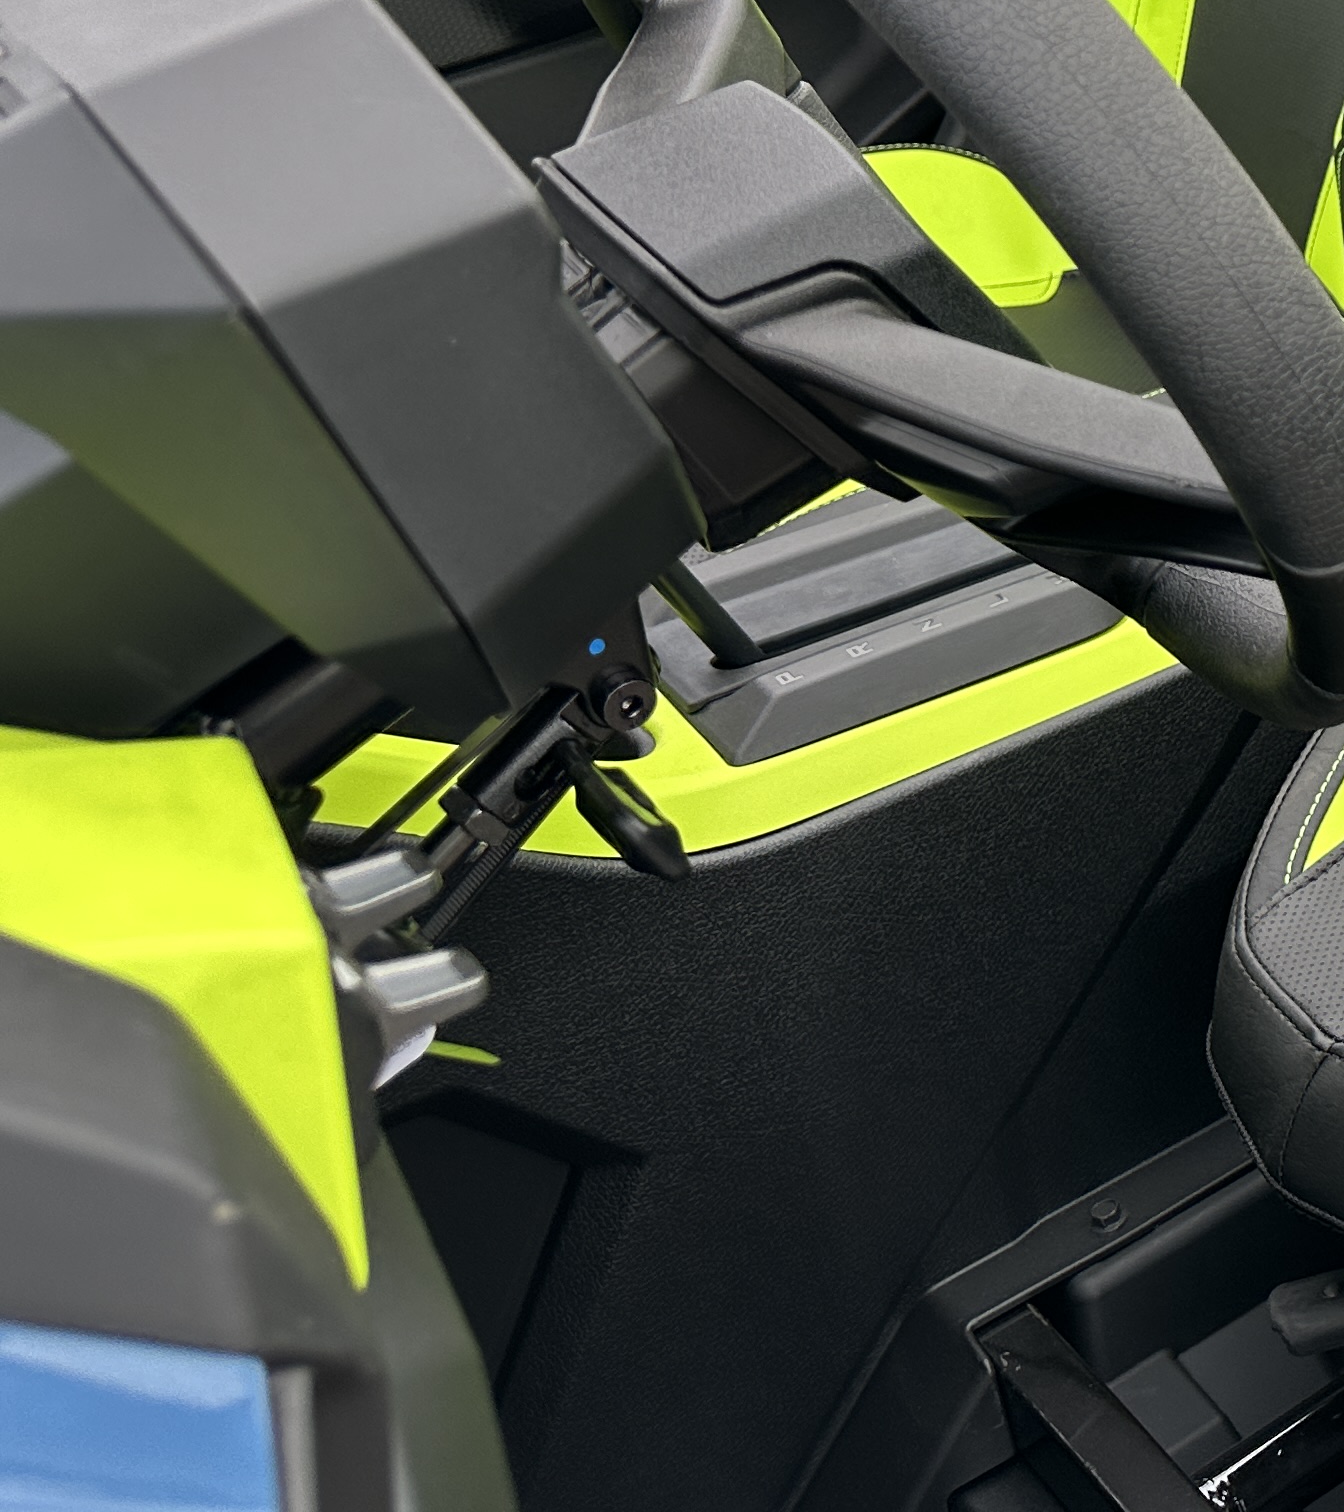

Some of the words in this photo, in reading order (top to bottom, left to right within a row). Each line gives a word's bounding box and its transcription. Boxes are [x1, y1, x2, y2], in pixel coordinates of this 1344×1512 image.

[775, 669, 806, 688] P
[845, 641, 875, 660] R
[914, 616, 943, 635] N
